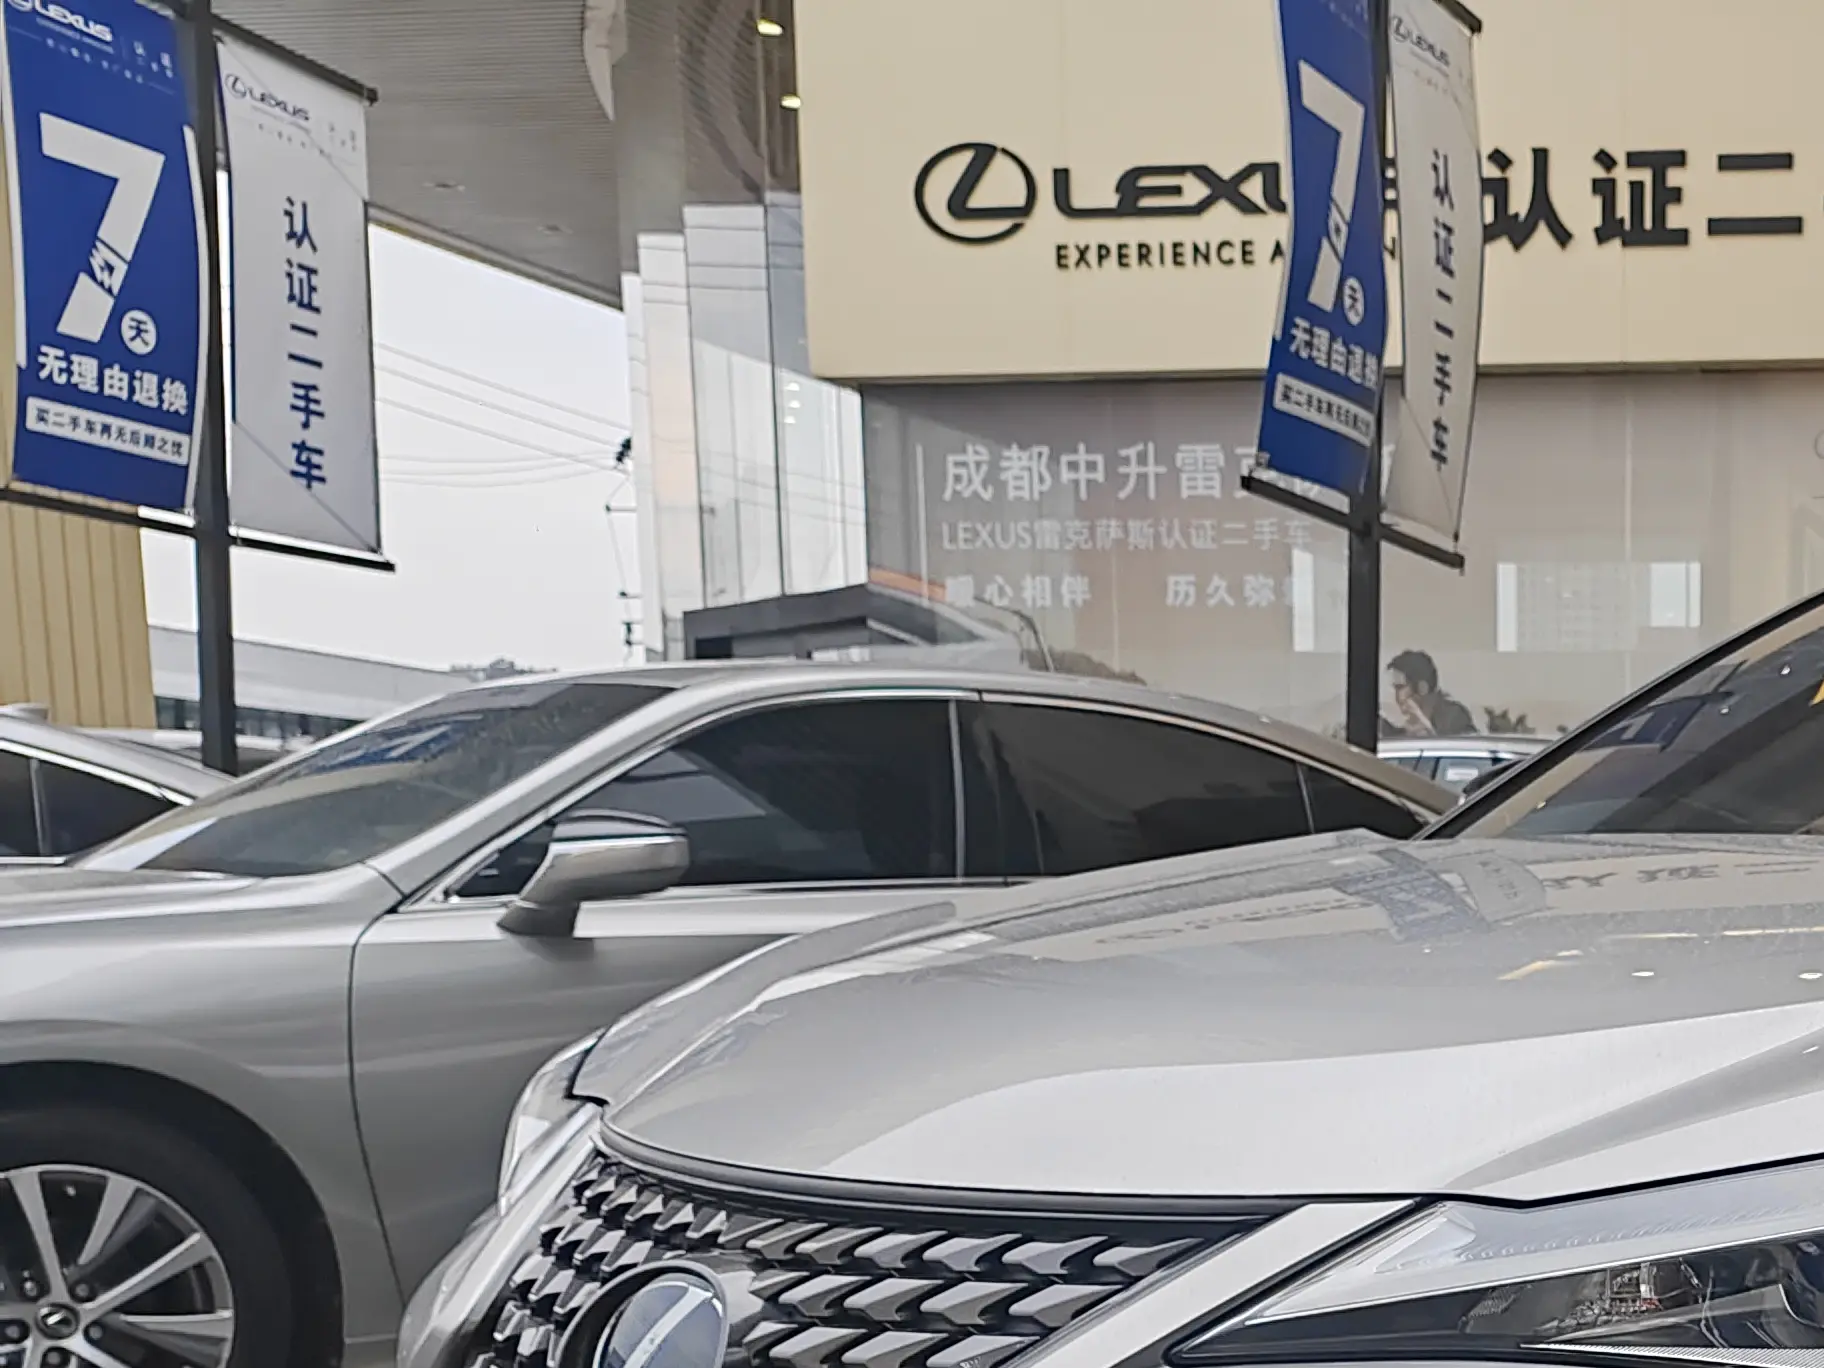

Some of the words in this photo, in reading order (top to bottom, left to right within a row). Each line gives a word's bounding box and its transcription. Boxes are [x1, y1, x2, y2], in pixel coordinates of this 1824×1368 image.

[1053, 162, 1397, 218] LEX
[1056, 238, 1254, 269] EXPERIENCE
[283, 196, 327, 490] 认证二手车
[38, 345, 188, 416] 无理由退换
